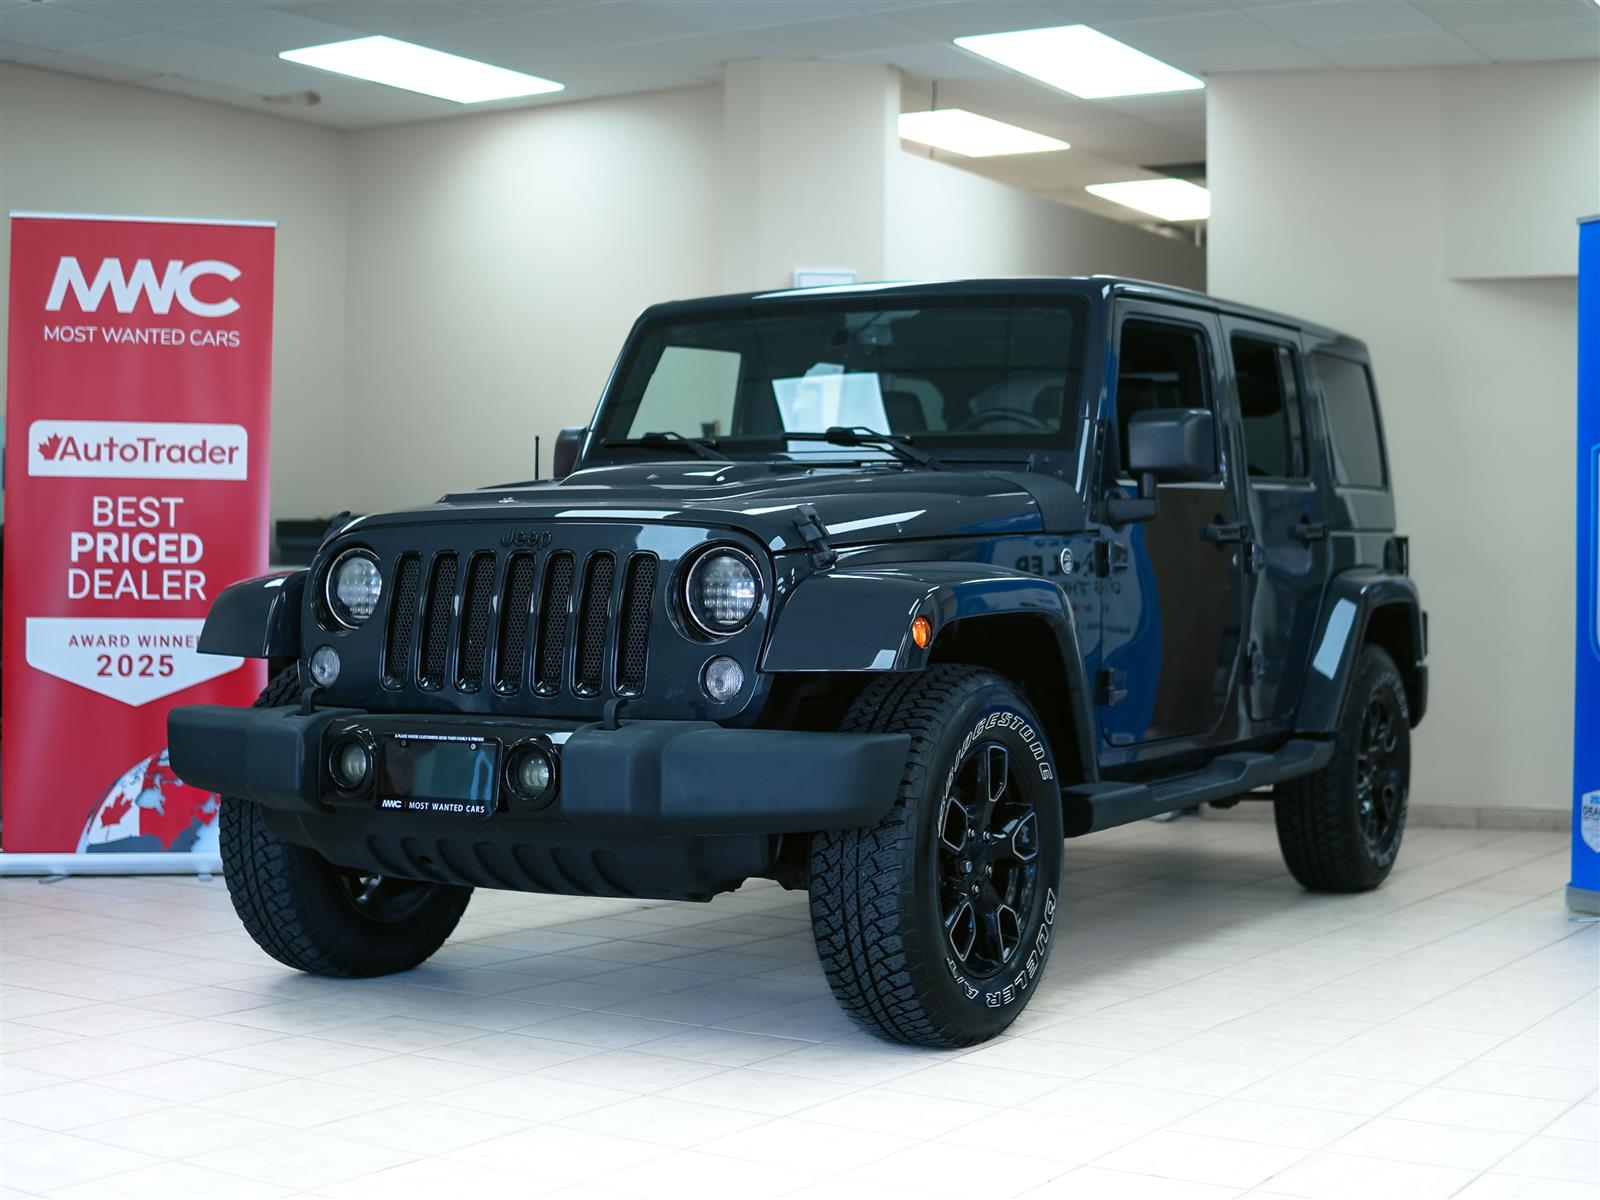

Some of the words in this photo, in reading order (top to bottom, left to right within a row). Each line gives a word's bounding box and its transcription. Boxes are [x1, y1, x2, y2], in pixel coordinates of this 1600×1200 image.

[45, 256, 242, 317] MWC
[44, 325, 97, 343] MOST
[102, 327, 185, 345] WANTED
[190, 330, 240, 347] CARS
[59, 436, 239, 464] AutoTrader
[92, 496, 184, 528] BEST
[70, 532, 204, 564] PRICED
[500, 528, 552, 550] Jeep
[68, 568, 207, 600] DEALER
[69, 634, 130, 648] AWARD
[96, 655, 175, 677] 2025
[382, 800, 402, 808] MWC
[409, 802, 429, 810] MOST
[432, 803, 463, 812] WANTED
[466, 805, 485, 813] CARS
[986, 887, 1057, 1007] DUELER
